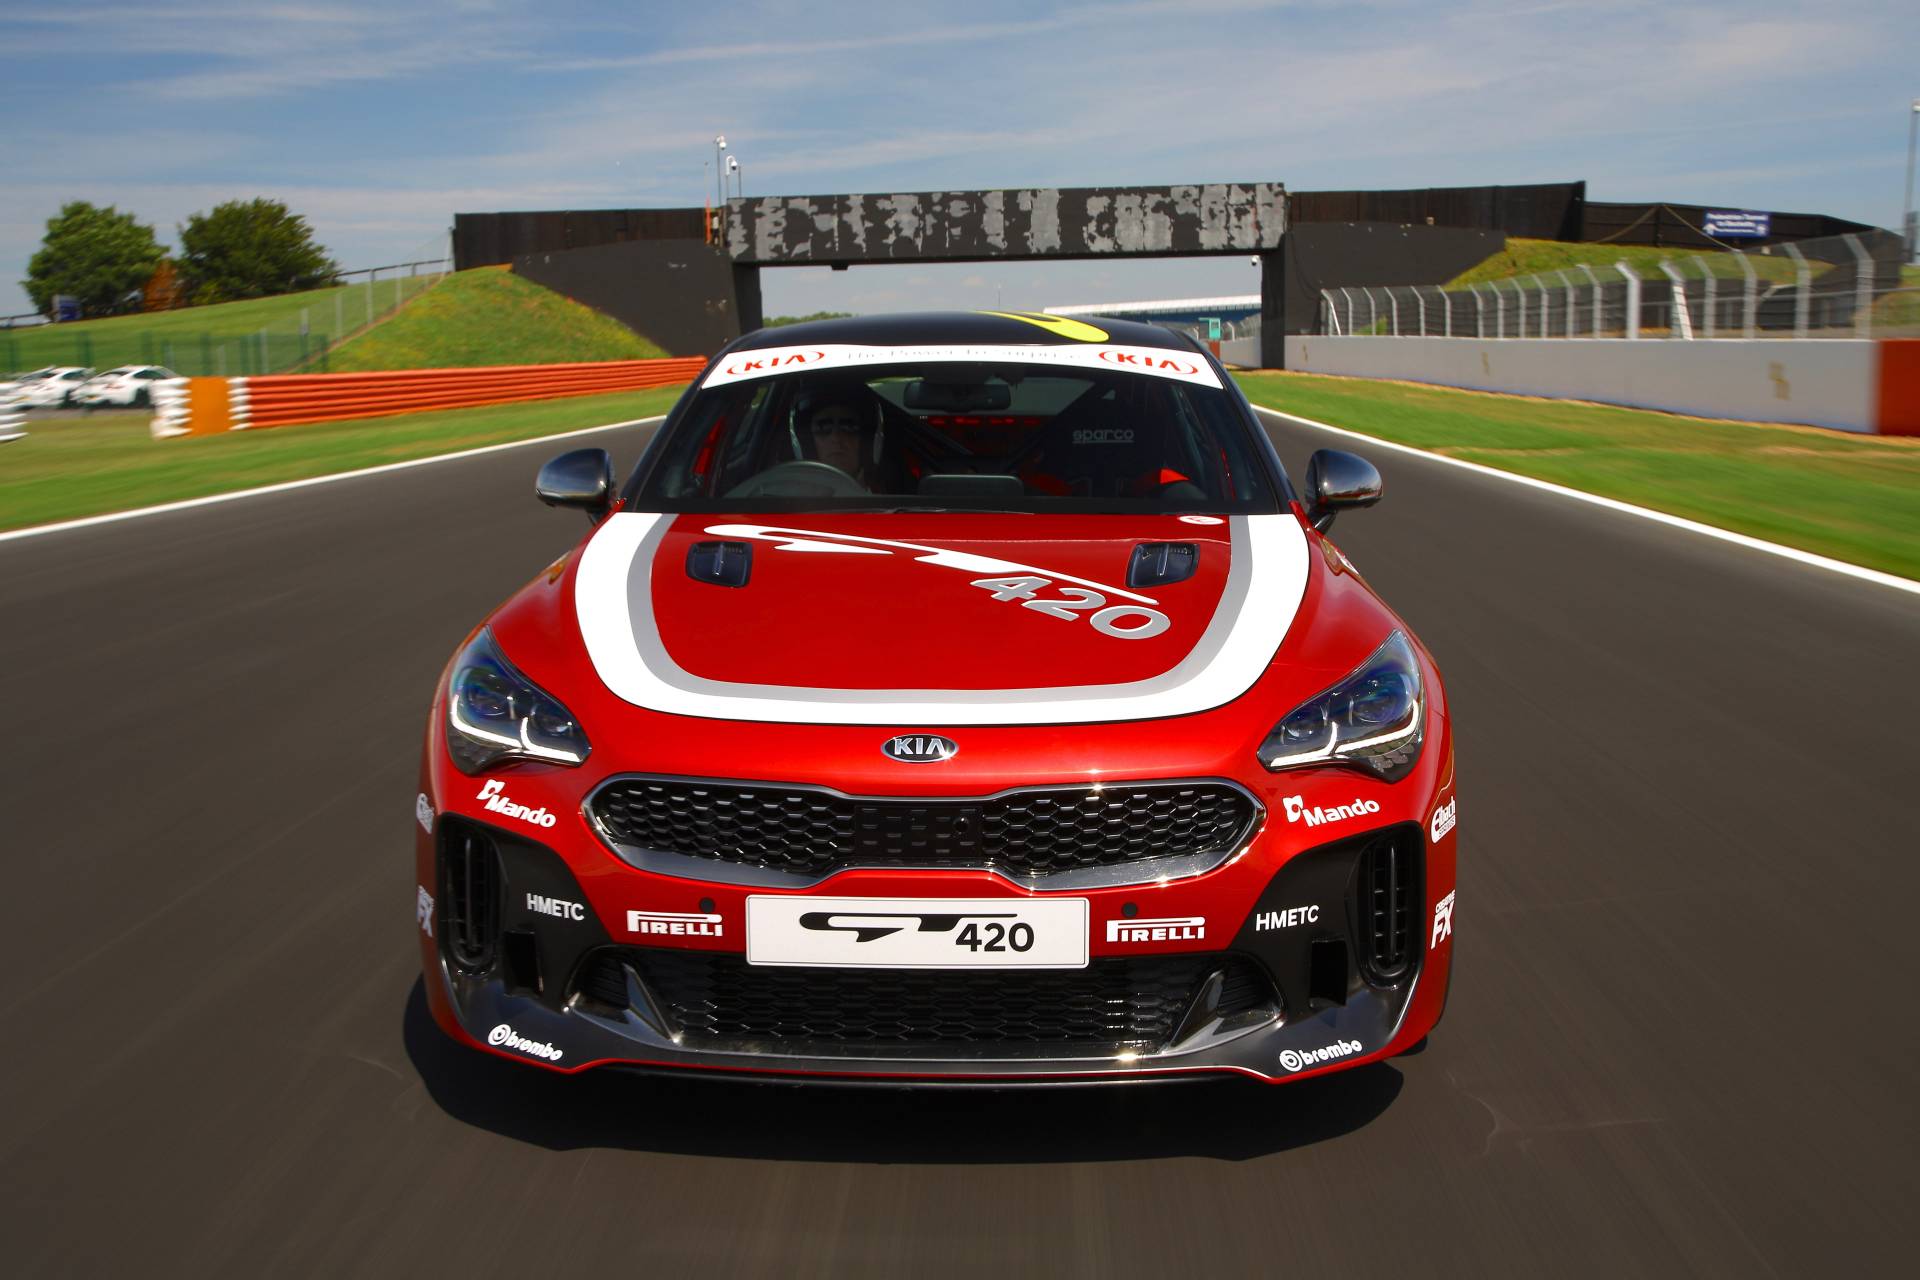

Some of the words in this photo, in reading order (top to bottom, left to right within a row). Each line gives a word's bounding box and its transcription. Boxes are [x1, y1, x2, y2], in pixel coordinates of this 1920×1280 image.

[744, 354, 806, 371] KIA
[1117, 353, 1181, 371] KIA
[1072, 429, 1135, 444] sparco
[970, 575, 1170, 639] 420
[894, 738, 946, 755] KIA
[484, 794, 556, 828] Mando
[1302, 799, 1381, 827] Mando
[527, 893, 585, 921] HMETC
[1255, 905, 1319, 931] HMETC
[626, 910, 723, 937] PIRELLI
[1106, 916, 1206, 942] PIRELLI
[1431, 900, 1455, 950] FX
[955, 923, 1034, 953] 420
[503, 1031, 564, 1061] brembo
[1298, 1039, 1363, 1065] brembo
